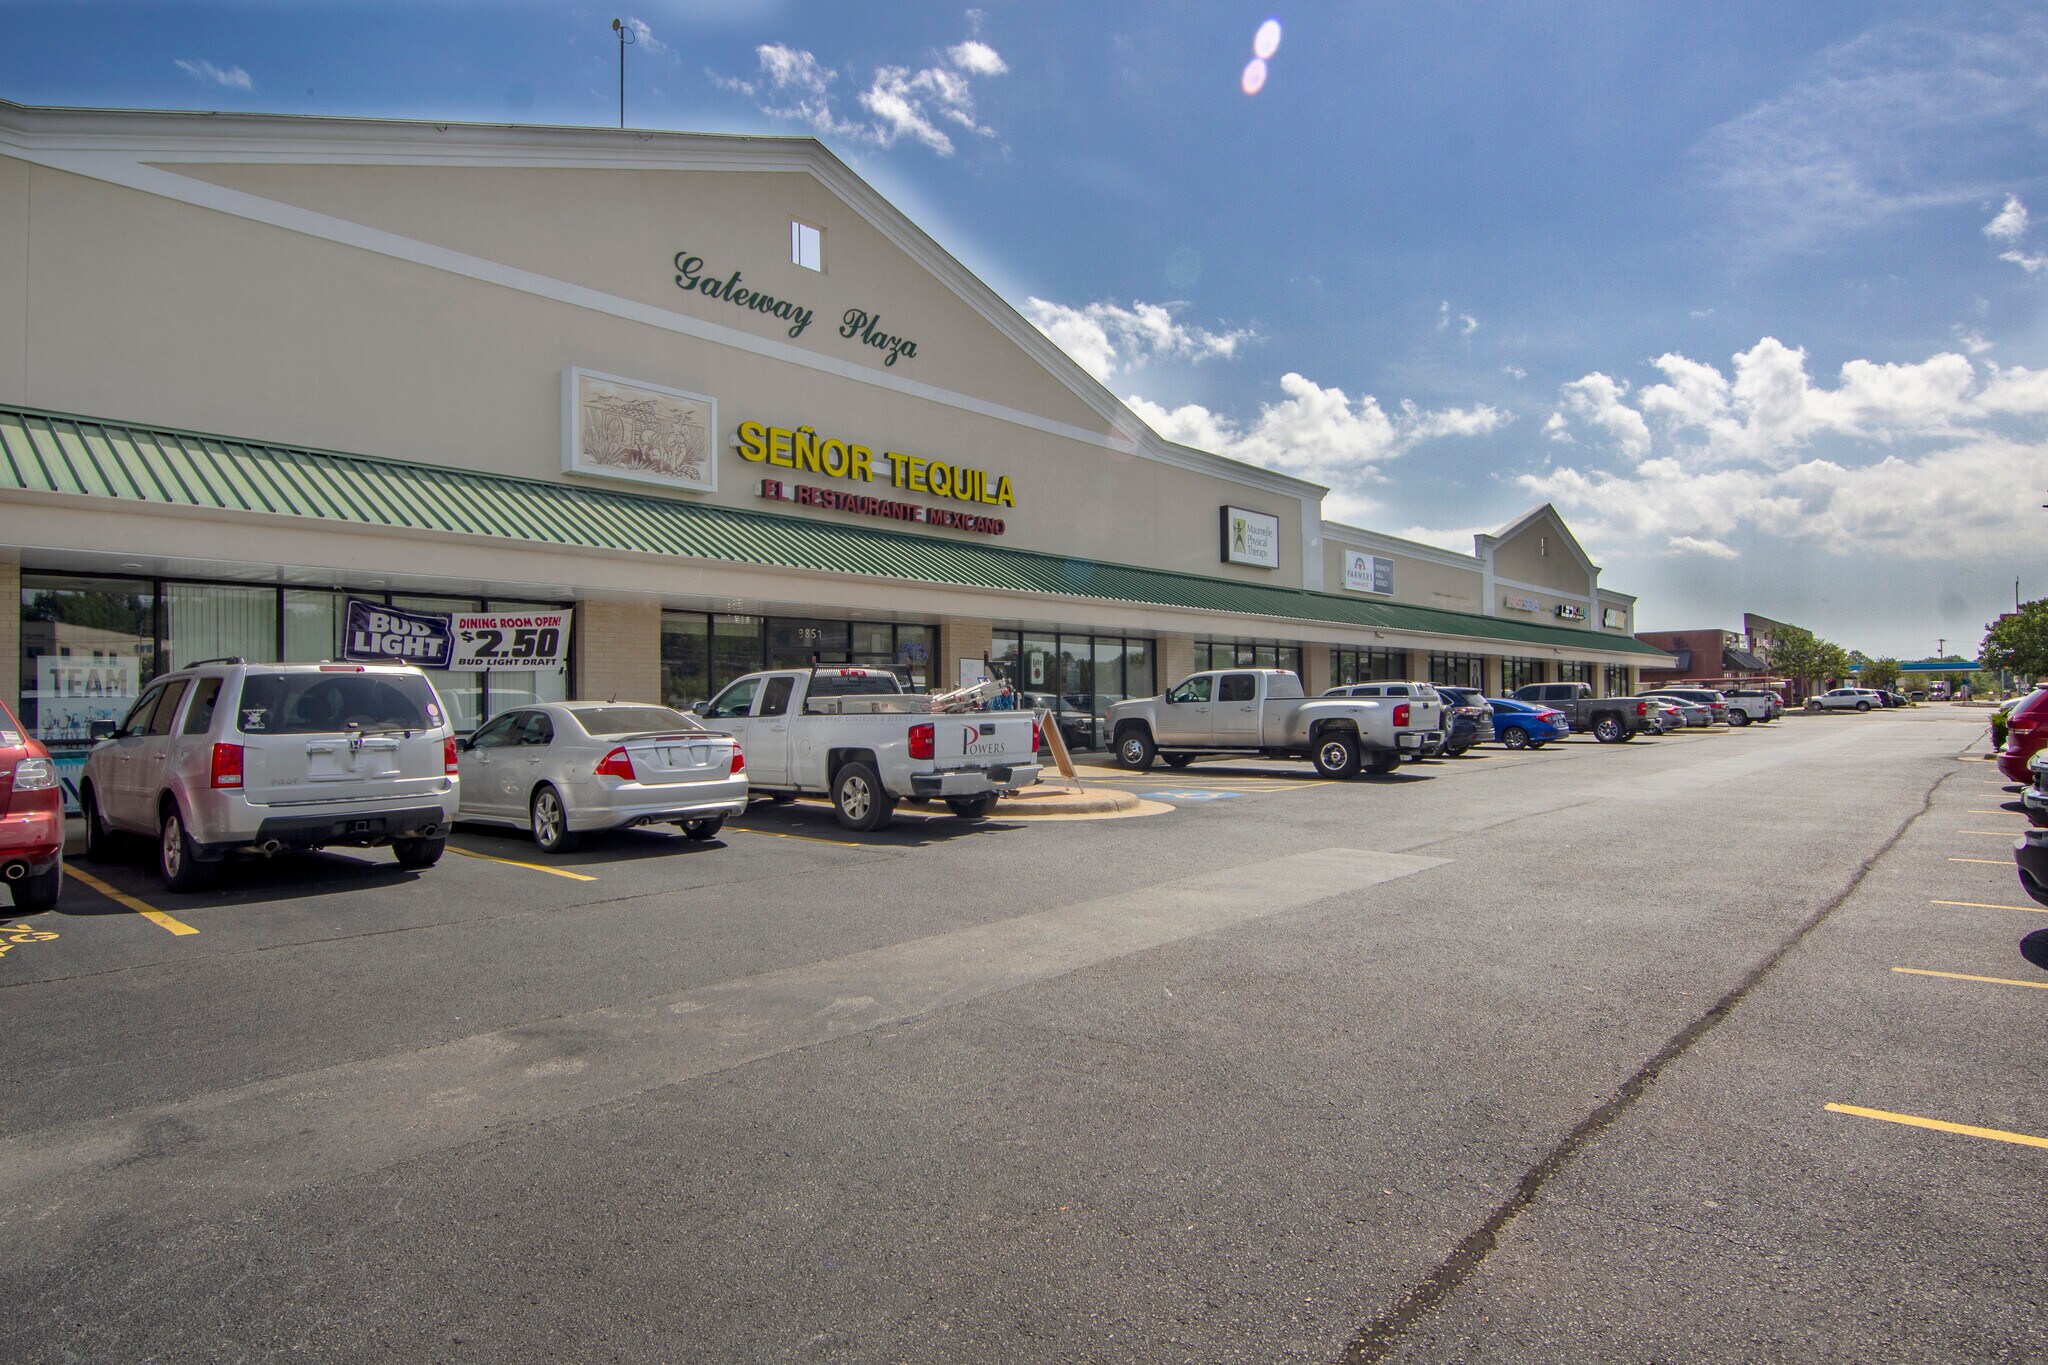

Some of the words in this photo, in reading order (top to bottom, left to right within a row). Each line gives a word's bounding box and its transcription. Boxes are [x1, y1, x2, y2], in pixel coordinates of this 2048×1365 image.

[674, 251, 813, 338] Gateway
[839, 308, 918, 367] Plaza
[736, 420, 873, 482] SEÑOR
[884, 451, 1016, 507] TEQUILA
[761, 478, 790, 500] EL
[794, 484, 923, 523] RESTAURANTE
[926, 507, 1006, 535] MEXICANO
[1247, 524, 1273, 538] Maumelle
[1247, 536, 1268, 547] Physical
[1247, 545, 1269, 561] Therapy
[1347, 569, 1373, 582] FARMERS
[369, 612, 431, 637] BUD
[459, 618, 497, 629] DINING
[500, 616, 532, 627] ROOM
[535, 616, 562, 627] OPEN!
[460, 628, 559, 657] $2.50
[798, 628, 822, 639] 9851
[458, 658, 484, 666] BUD
[487, 658, 519, 666] LIGHT
[522, 658, 557, 666] DRAFT
[50, 668, 127, 698] TEAM
[961, 724, 1005, 755] POWERS
